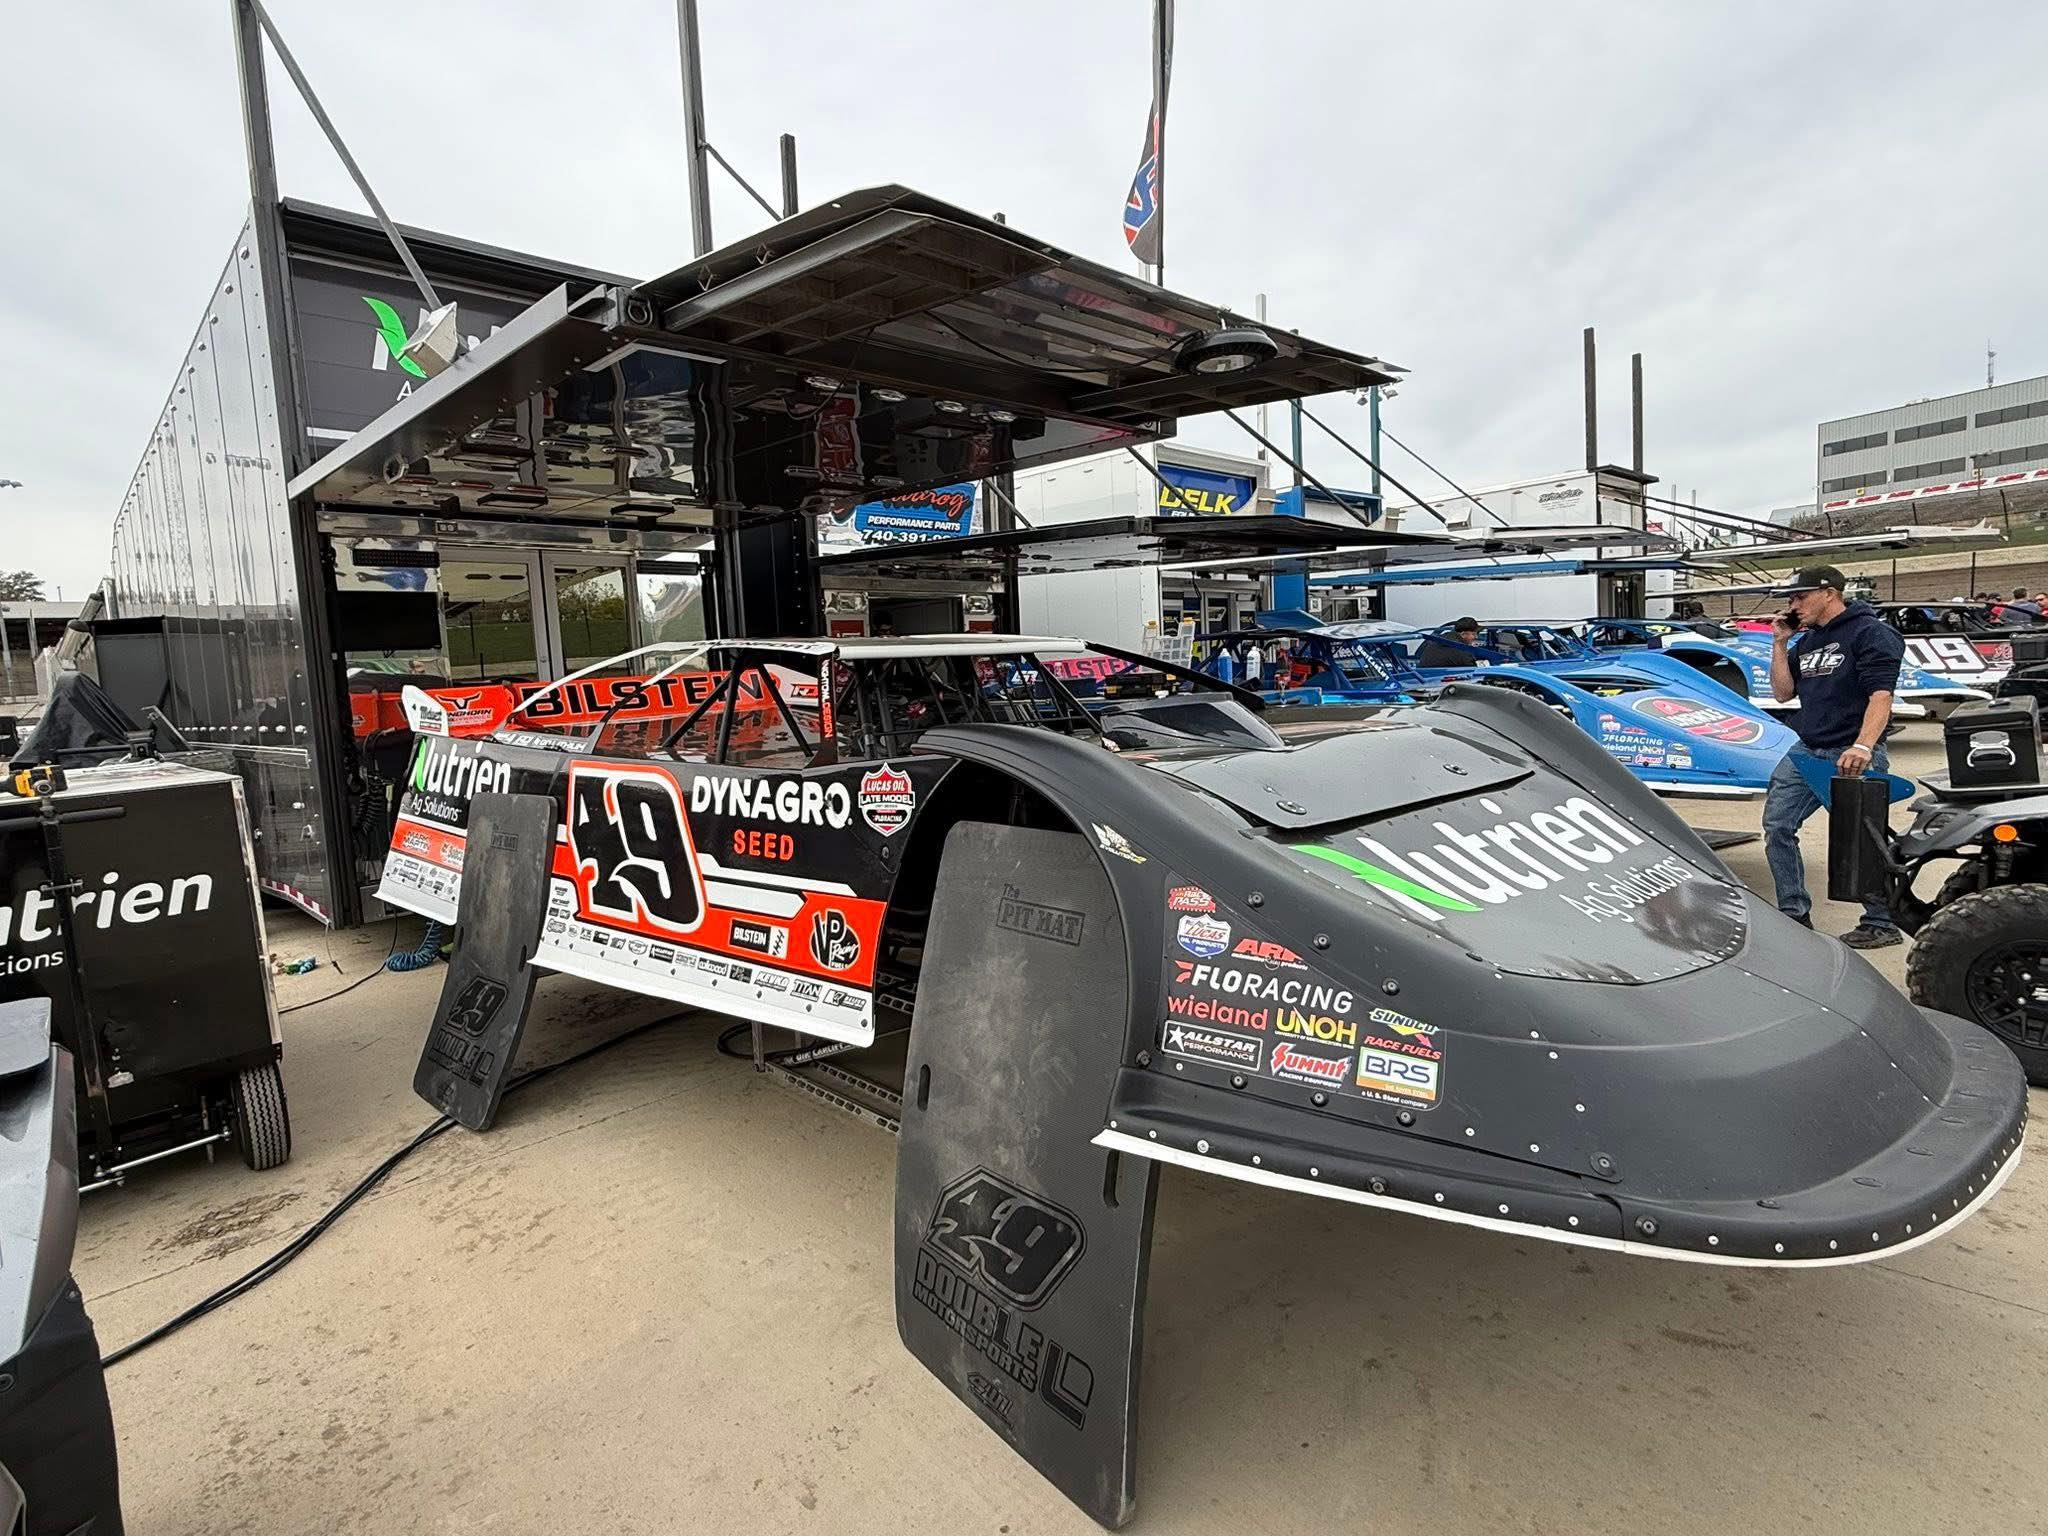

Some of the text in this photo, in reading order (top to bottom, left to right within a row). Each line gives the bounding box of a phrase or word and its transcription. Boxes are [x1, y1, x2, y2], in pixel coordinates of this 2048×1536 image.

[1159, 485, 1237, 515] DELK
[867, 515, 961, 532] PERFORMANCE PARTS
[447, 708, 492, 718] NGHORN
[408, 736, 511, 800] Nutrien
[861, 794, 913, 805] LATE MODEL
[866, 779, 905, 792] LUCAS OIL
[411, 793, 460, 822] Ag Solutions
[691, 775, 852, 829] DYNAGRO
[569, 760, 706, 932] 49
[733, 828, 795, 861] SEED
[1350, 797, 1644, 922] Nutrien
[1173, 896, 1210, 907] PASS
[1559, 857, 1694, 924] Ag Solutions
[0, 871, 213, 946] trien
[1000, 902, 1080, 940] PIT MAT
[733, 926, 768, 946] BILSTEIN
[1185, 925, 1227, 941] LUCAS
[794, 979, 821, 998] TITAN
[1190, 964, 1354, 1014] FLORACING
[1167, 994, 1268, 1031] wieland
[1276, 1006, 1358, 1045] UNOH
[1372, 1009, 1436, 1033] SUNOCO
[1183, 1040, 1255, 1062] PERFORMANCE
[1184, 1029, 1258, 1053] ALLSTAR
[1364, 1035, 1442, 1060] RACE FUELS
[1278, 1071, 1304, 1081] RACING
[1365, 1055, 1431, 1084] BRS
[1400, 1097, 1428, 1109] company
[924, 1165, 1087, 1312] 49
[914, 1248, 1044, 1371] DOUBLE
[913, 1280, 1038, 1393] MOTORSPORTS
